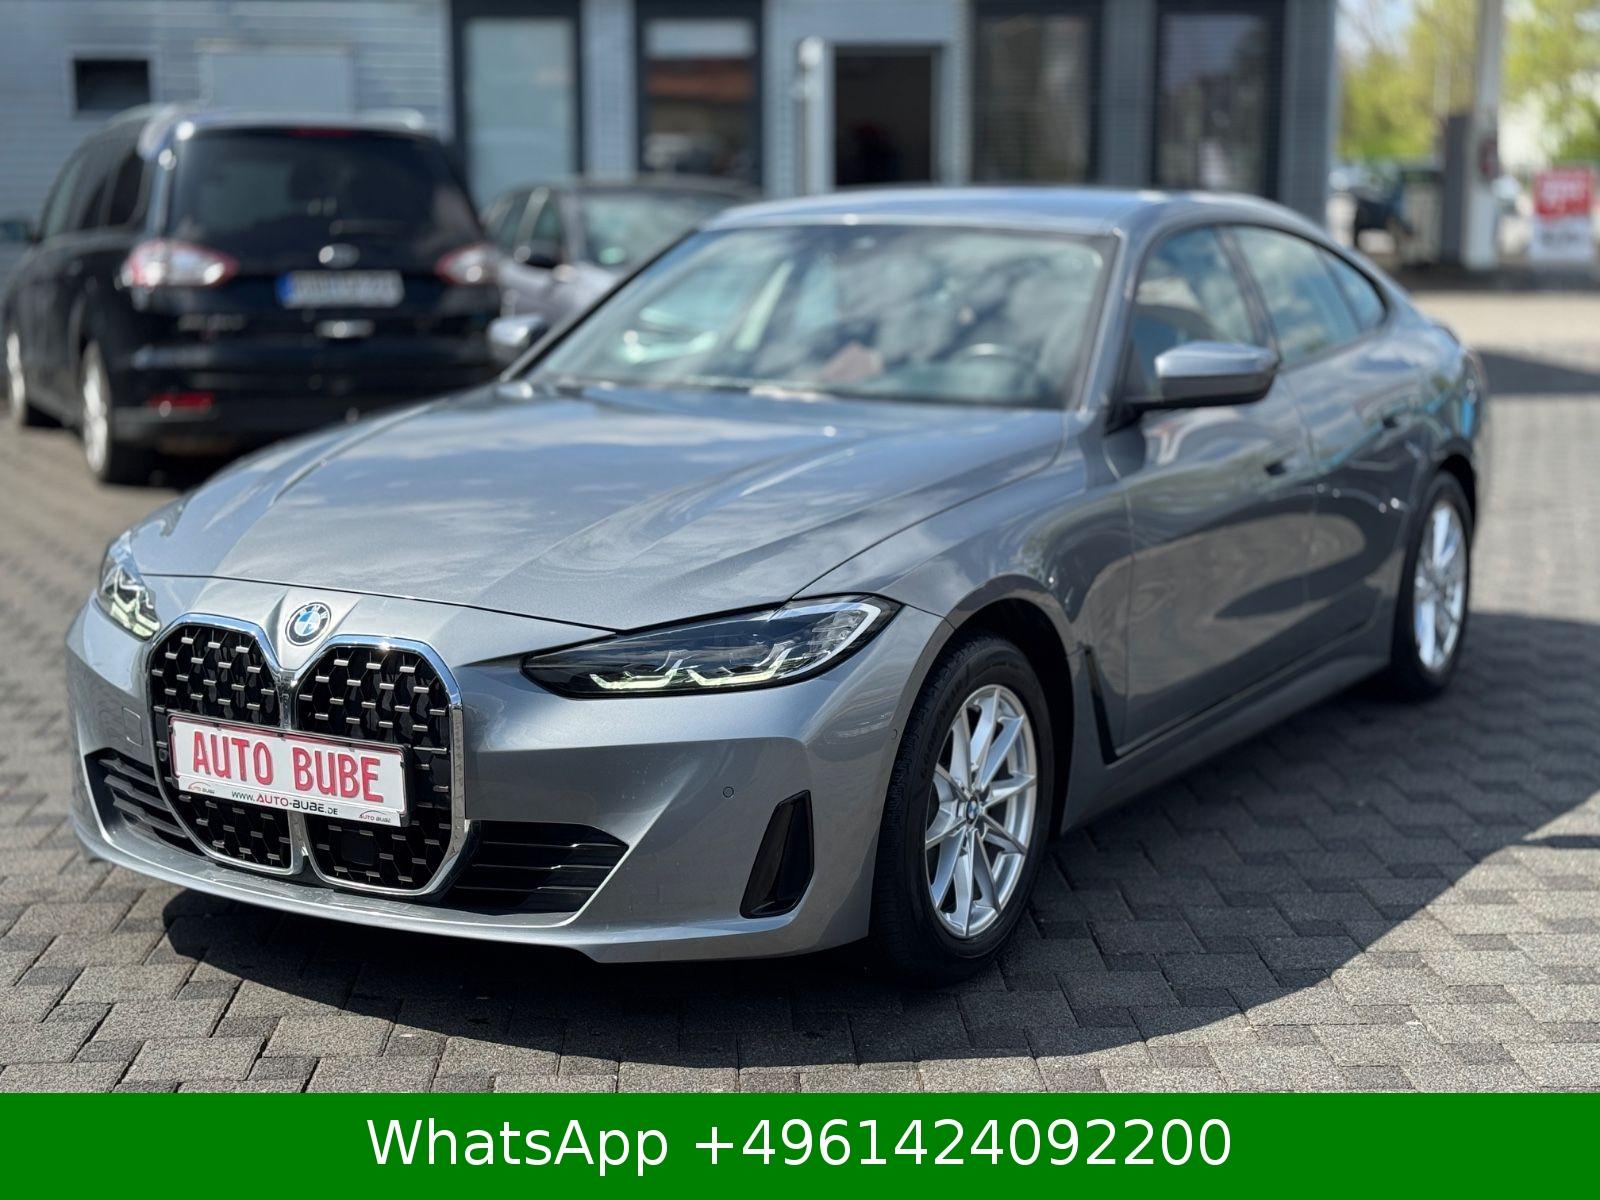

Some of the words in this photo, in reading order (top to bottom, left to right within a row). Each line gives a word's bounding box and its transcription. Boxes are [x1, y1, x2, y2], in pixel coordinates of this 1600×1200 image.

[193, 731, 274, 786] AUTO
[292, 746, 385, 803] BUBE
[231, 791, 339, 816] www.AUTO-BUBE.DE
